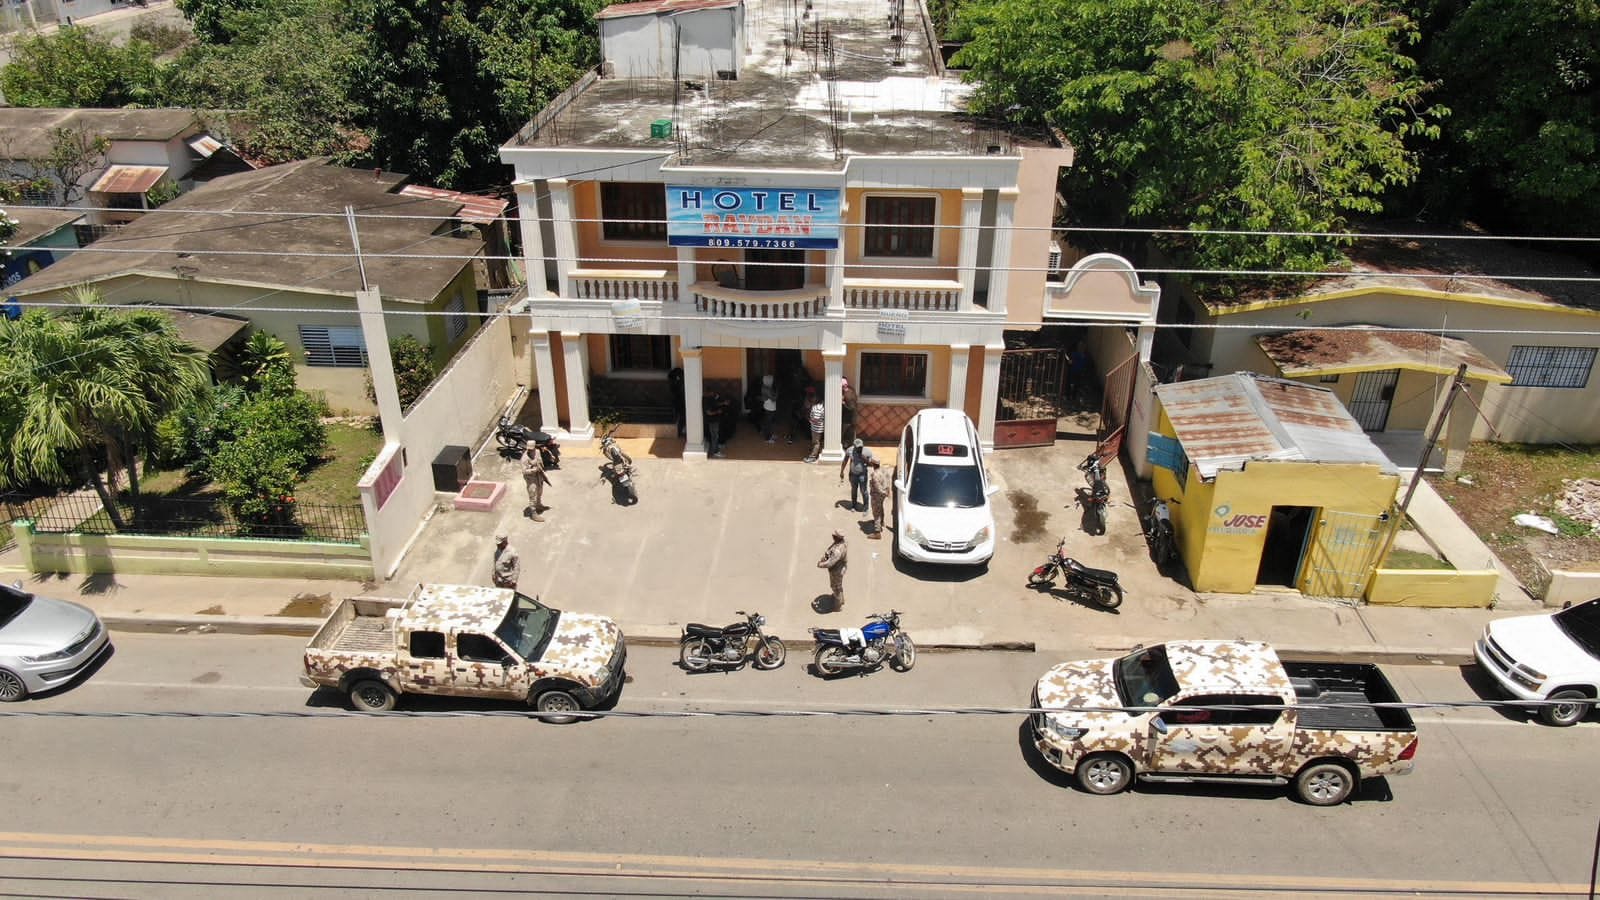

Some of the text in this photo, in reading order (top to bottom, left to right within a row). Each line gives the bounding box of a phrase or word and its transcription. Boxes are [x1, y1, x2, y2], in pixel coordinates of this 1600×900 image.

[681, 191, 822, 211] HOTEL
[703, 214, 813, 235] RAYDAN
[1223, 514, 1267, 528] JOSE
